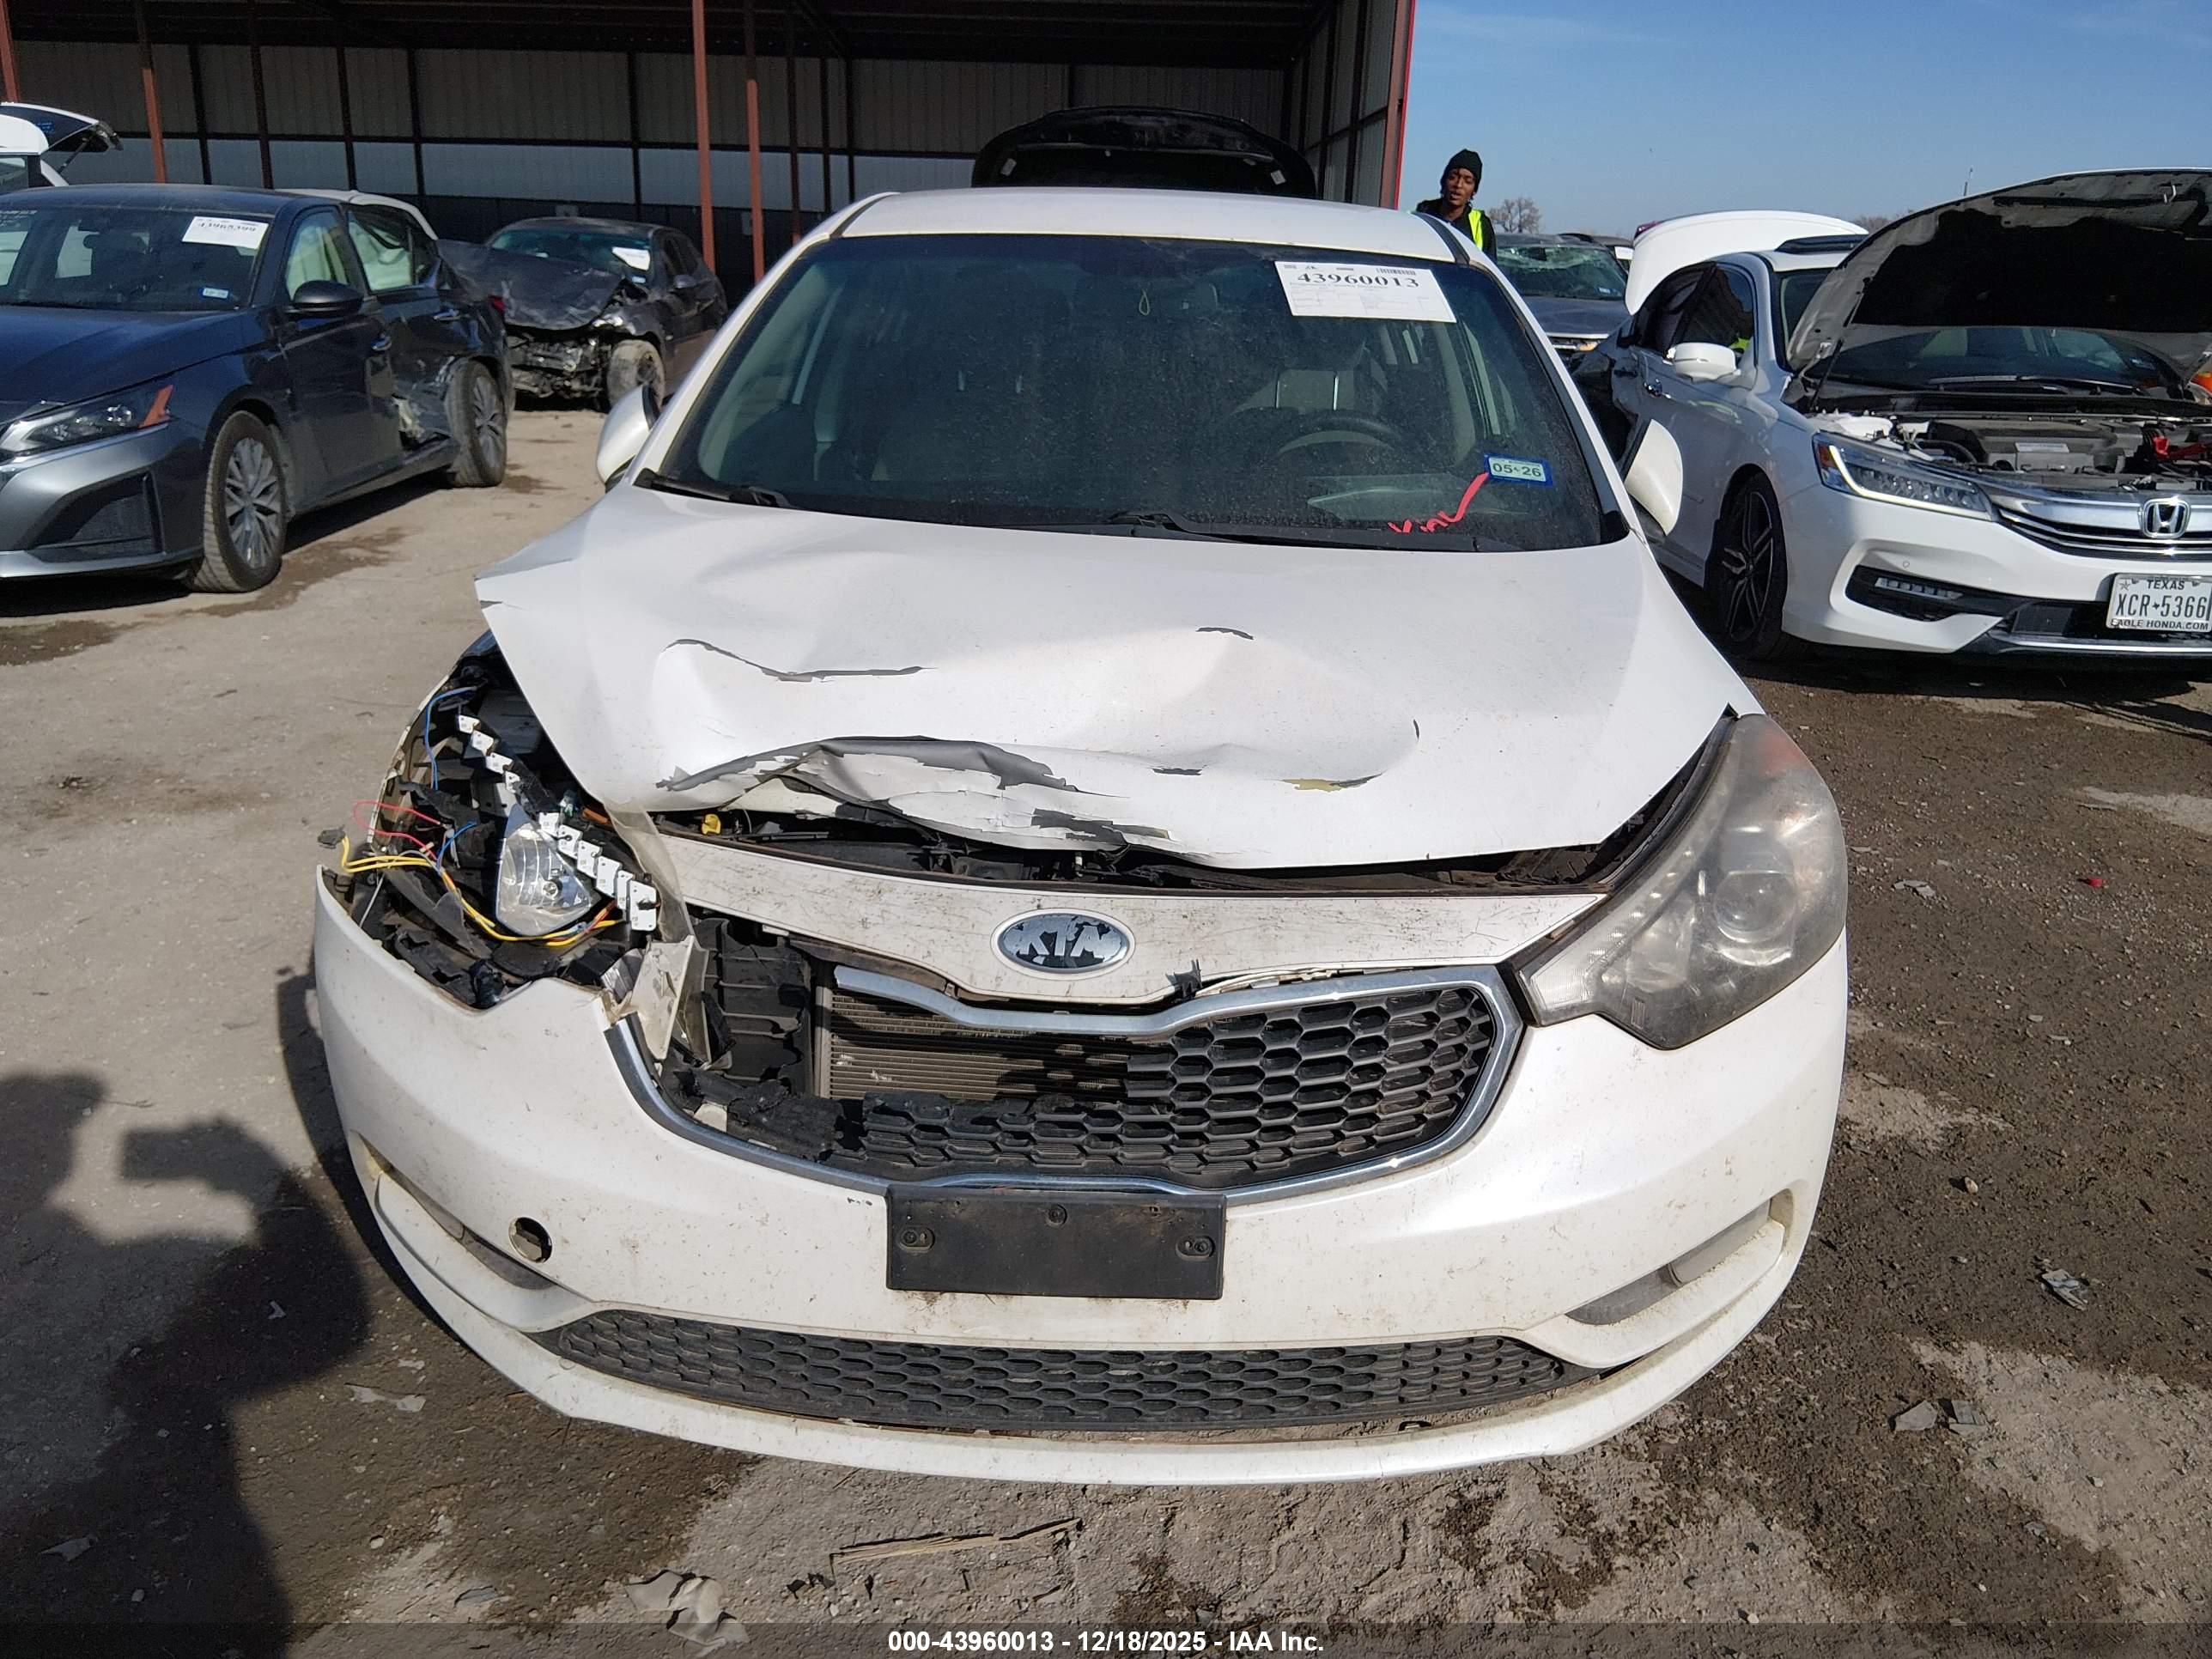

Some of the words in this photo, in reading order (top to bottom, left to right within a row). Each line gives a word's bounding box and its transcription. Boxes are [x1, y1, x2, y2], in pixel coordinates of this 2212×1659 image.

[1297, 272, 1419, 288] 43960013
[1492, 463, 1513, 473] 05
[1522, 465, 1542, 477] 26
[2147, 580, 2185, 590] TEXAS
[2116, 593, 2151, 617] XCR
[2160, 595, 2208, 618] 5366
